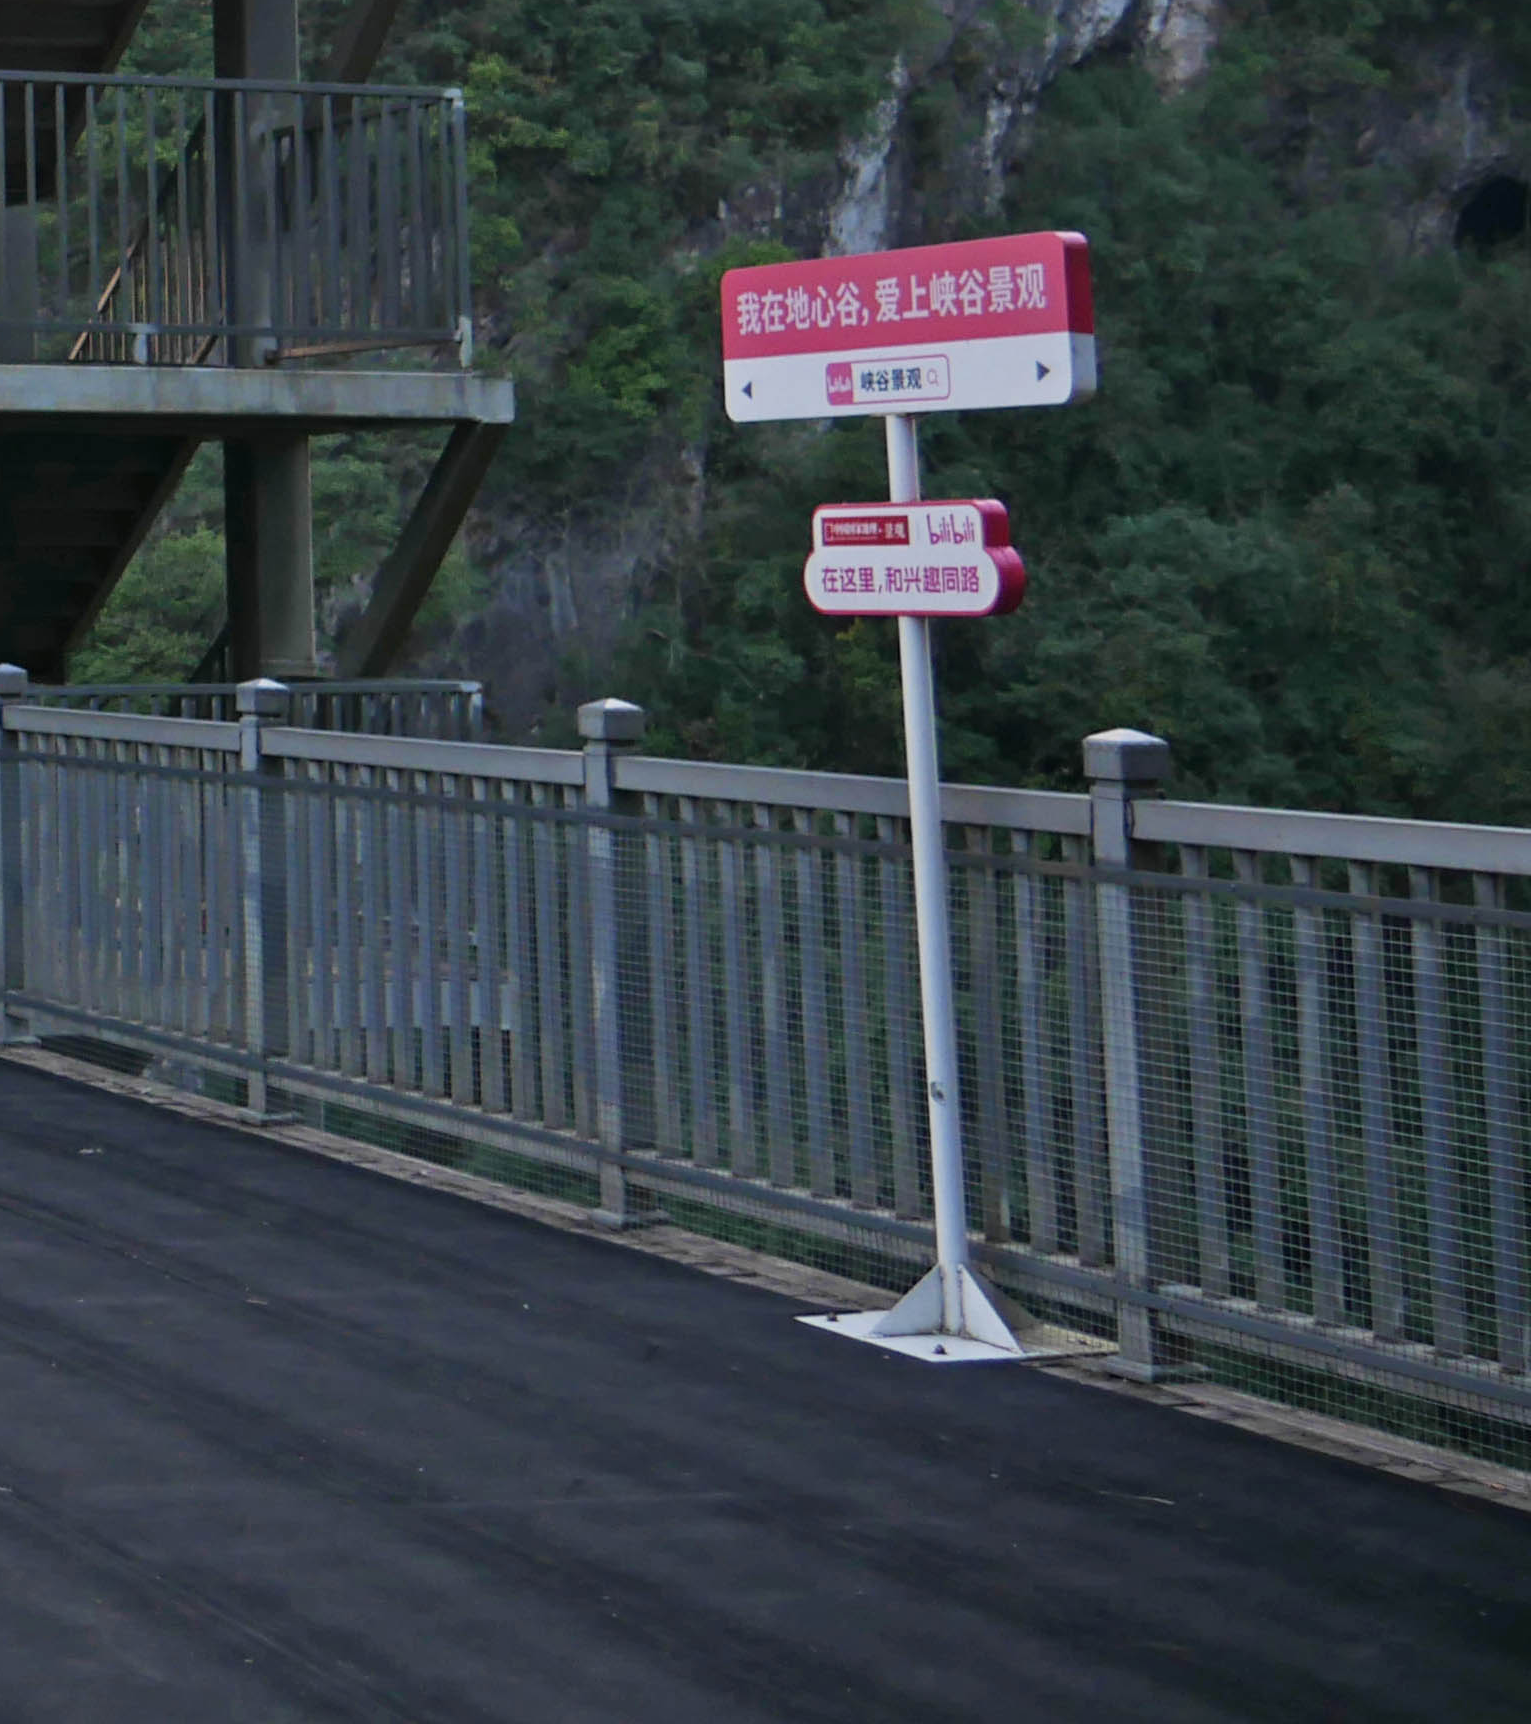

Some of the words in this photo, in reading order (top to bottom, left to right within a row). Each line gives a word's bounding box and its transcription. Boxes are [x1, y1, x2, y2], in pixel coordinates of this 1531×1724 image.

[736, 262, 1047, 336] 我在地心谷，爱上峡谷景观
[861, 367, 922, 391] 峡谷景观
[926, 513, 976, 545] bilibili
[821, 565, 980, 594] 在这里，和兴趣同路
